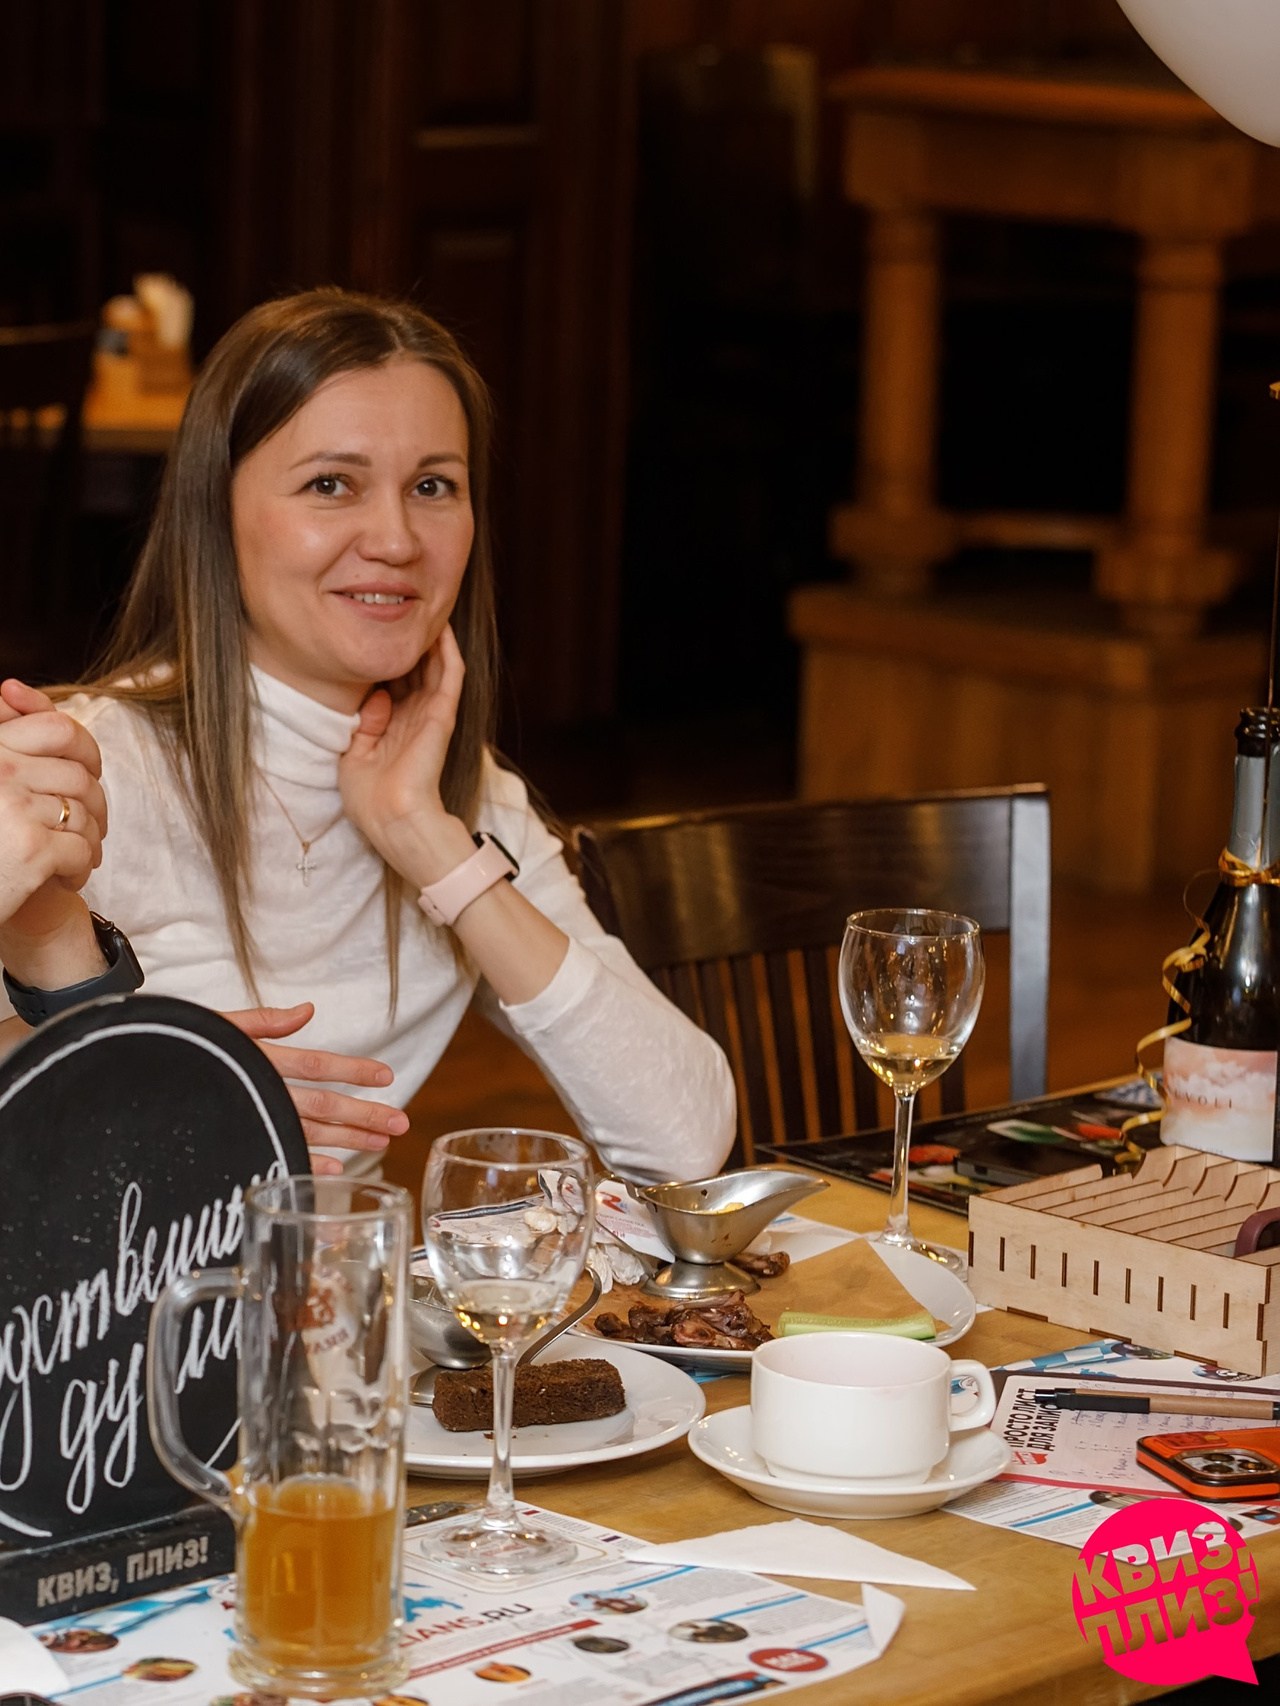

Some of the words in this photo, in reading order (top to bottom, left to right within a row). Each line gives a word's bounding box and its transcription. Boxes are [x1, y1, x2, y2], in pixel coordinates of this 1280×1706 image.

[1012, 1388, 1037, 1414] ЛИСТ
[1003, 1413, 1033, 1448] ПРОСТО
[1026, 1432, 1056, 1452] ДЛЯ
[36, 1562, 119, 1608] КВИЗ,
[125, 1536, 209, 1584] ПЛИЗ!
